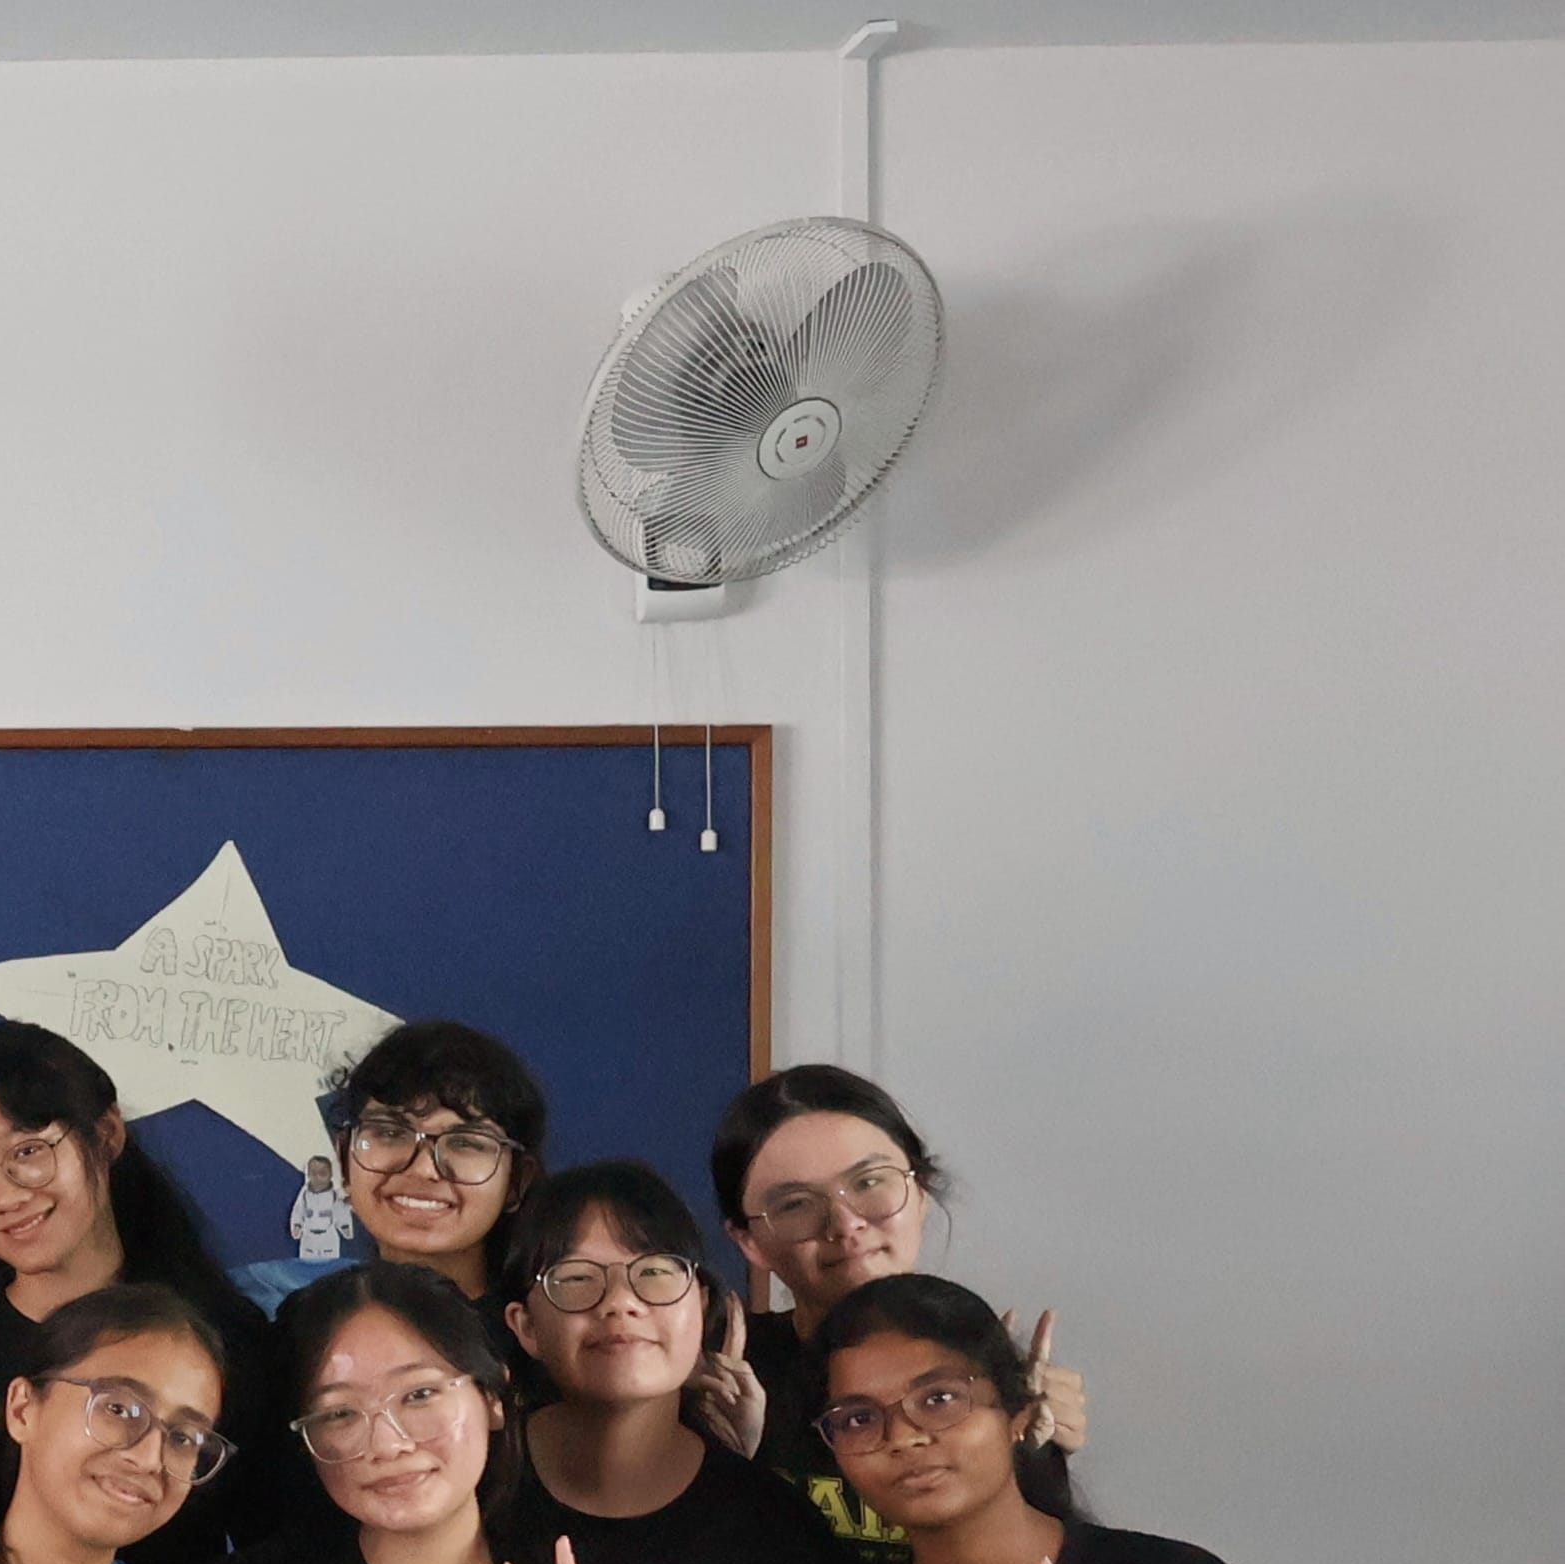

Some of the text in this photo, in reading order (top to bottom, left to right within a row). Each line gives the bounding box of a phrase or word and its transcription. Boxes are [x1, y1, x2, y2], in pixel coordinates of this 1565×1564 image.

[182, 934, 281, 991] SPARK
[70, 980, 348, 1067] FROM THE HEART
